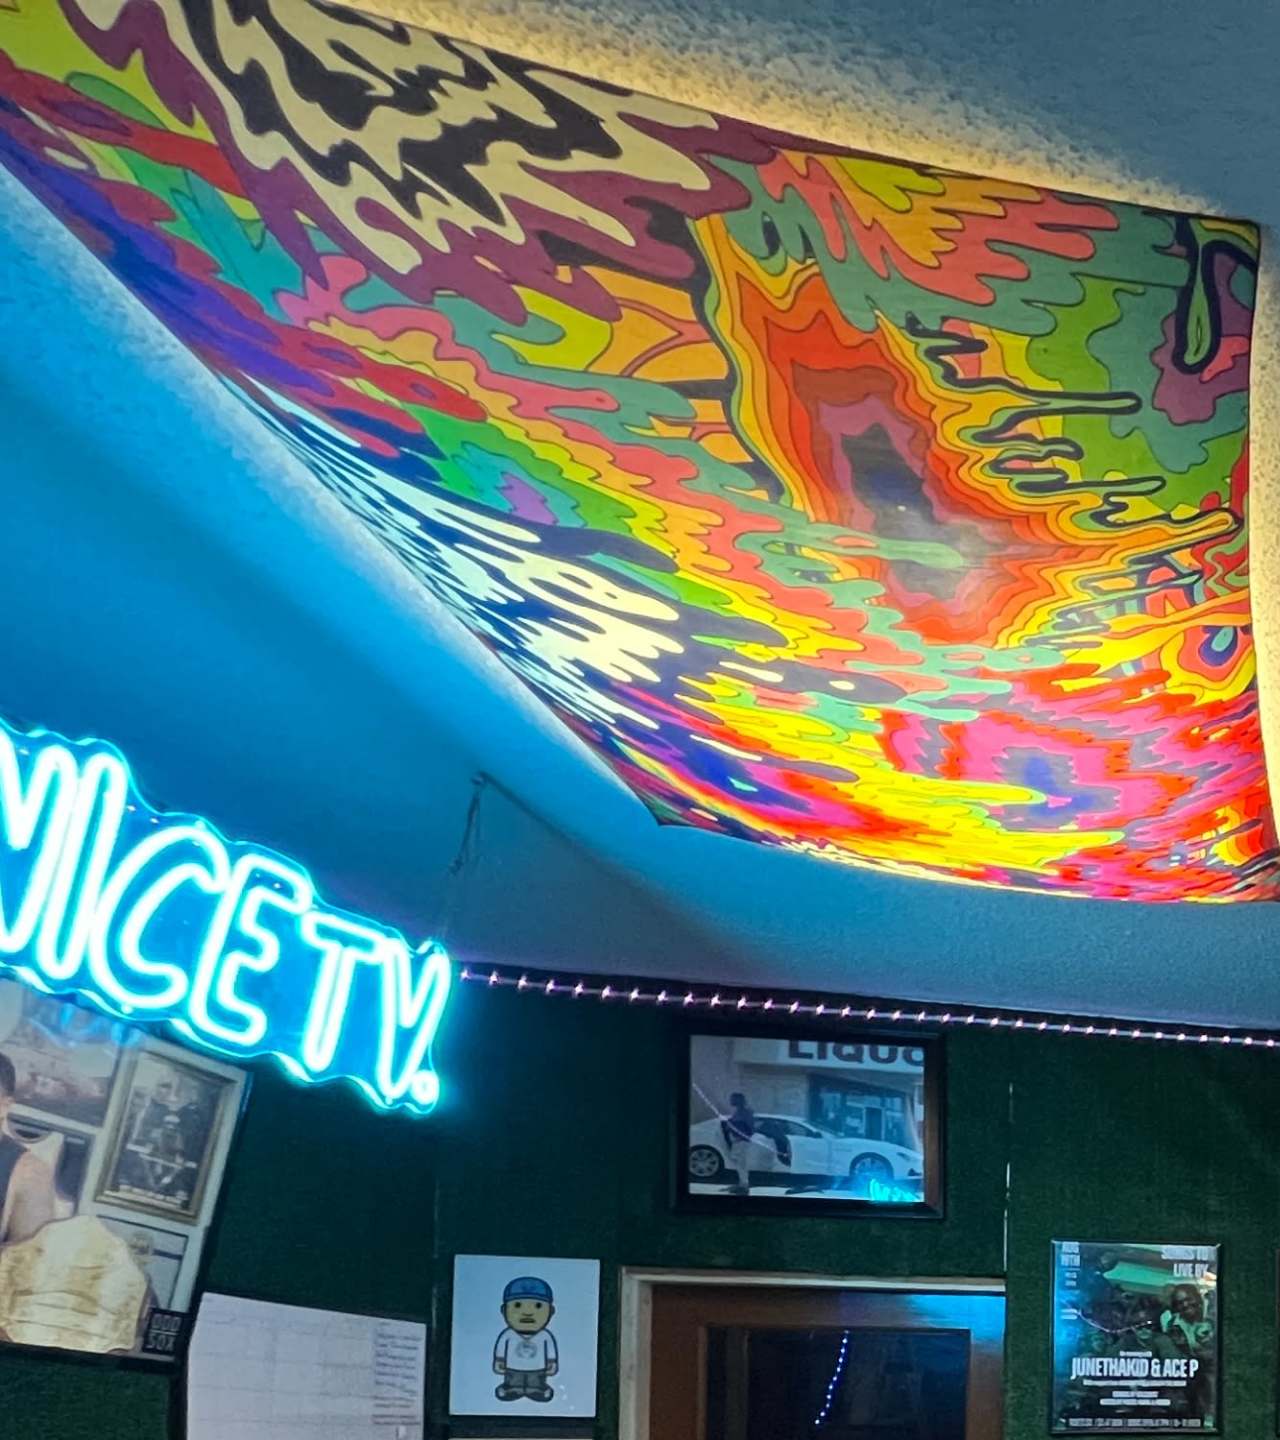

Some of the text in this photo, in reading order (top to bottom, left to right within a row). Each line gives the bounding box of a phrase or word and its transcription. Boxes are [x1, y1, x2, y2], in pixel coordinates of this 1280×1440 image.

[1070, 1357, 1149, 1380] JUNETHAKID
[1163, 1358, 1188, 1378] ACE
[1189, 1358, 1199, 1378] P
